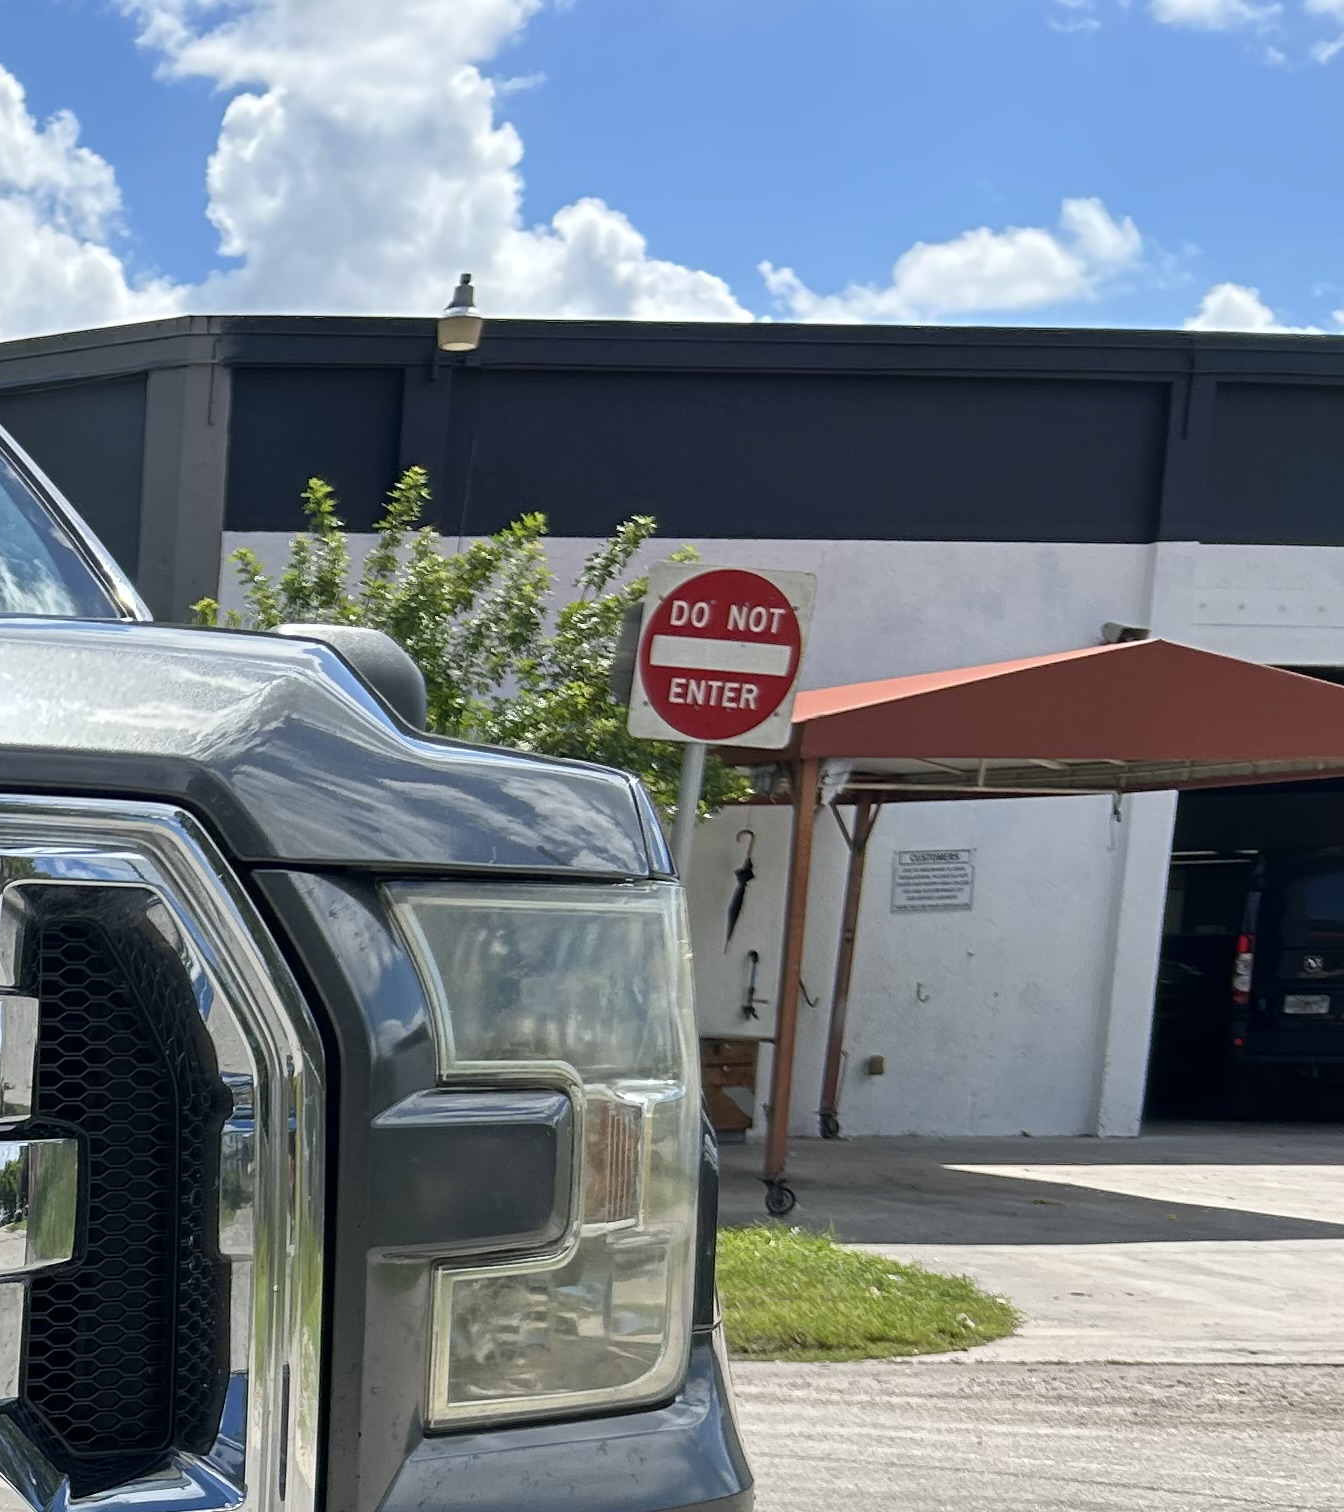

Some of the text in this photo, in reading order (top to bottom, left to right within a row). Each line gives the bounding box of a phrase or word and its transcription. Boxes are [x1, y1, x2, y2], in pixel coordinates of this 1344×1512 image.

[670, 600, 785, 634] DO NOT
[669, 677, 759, 709] ENTER
